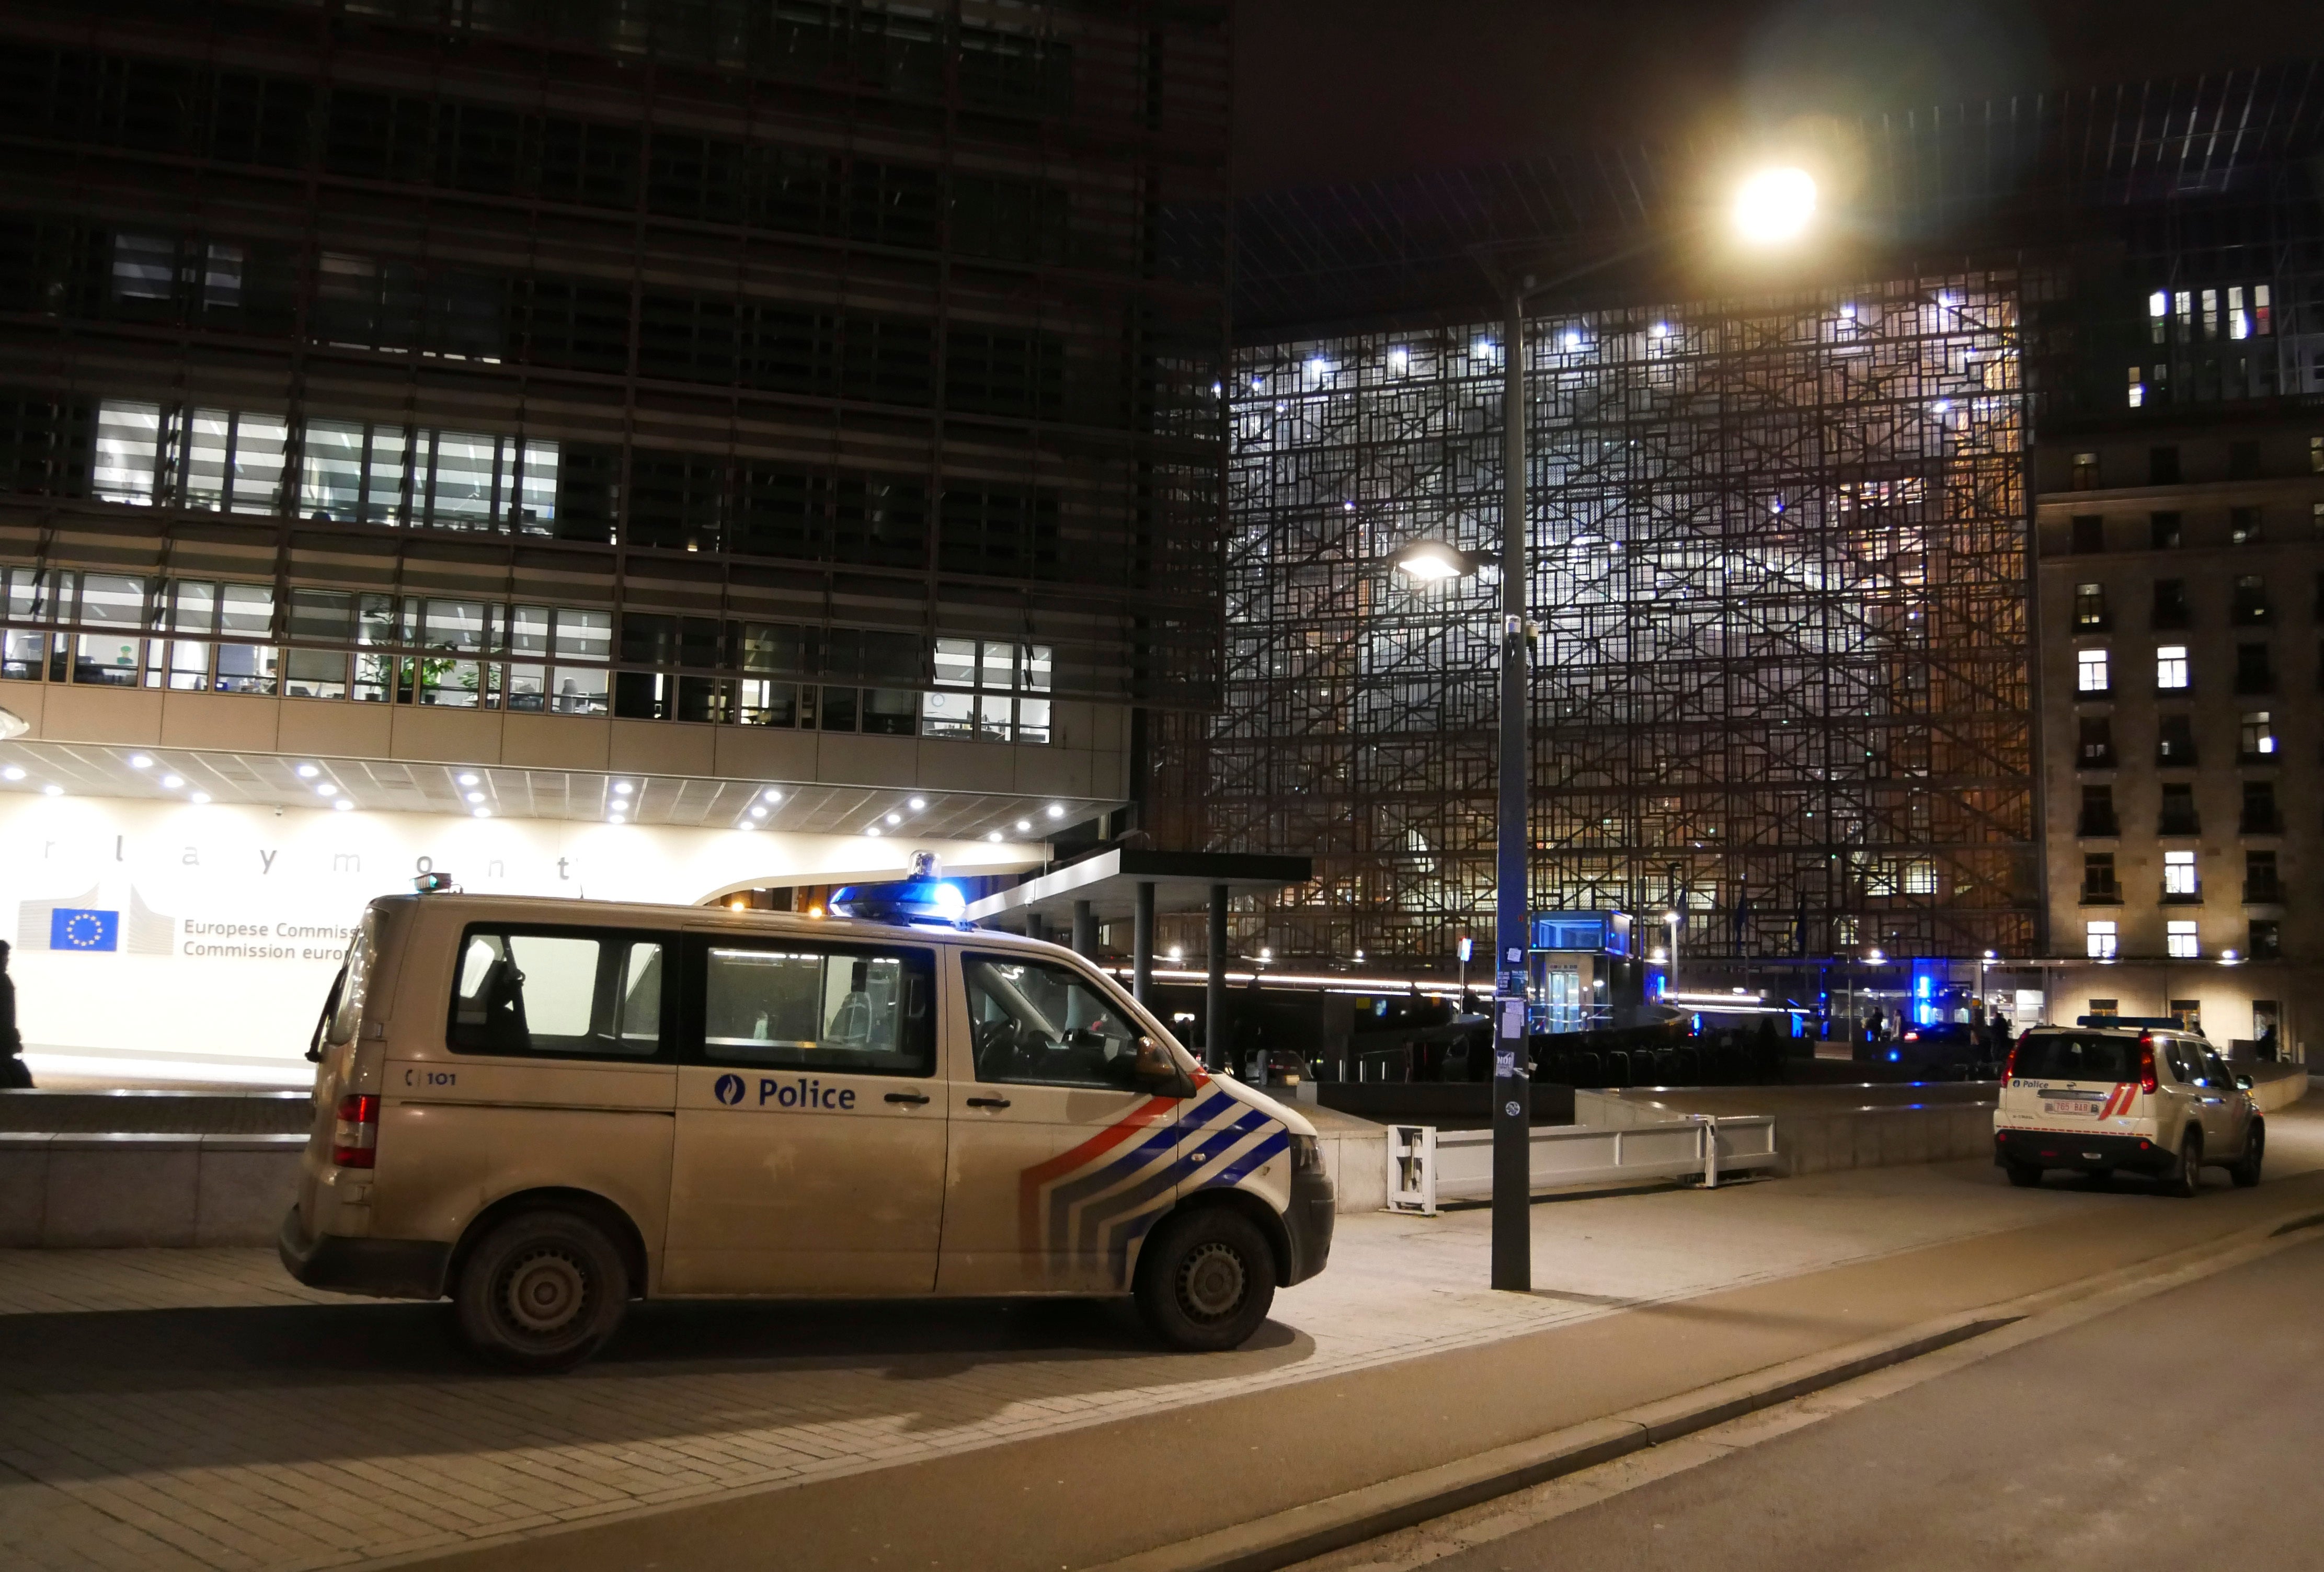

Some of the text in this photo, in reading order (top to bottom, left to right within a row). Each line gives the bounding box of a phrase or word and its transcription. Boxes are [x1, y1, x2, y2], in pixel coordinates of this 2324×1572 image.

[185, 919, 269, 938] Europese
[184, 941, 295, 959] Commission
[427, 1073, 456, 1086] 101
[2023, 1080, 2049, 1089] Police
[760, 1077, 856, 1110] Police
[2055, 1102, 2070, 1111] 765
